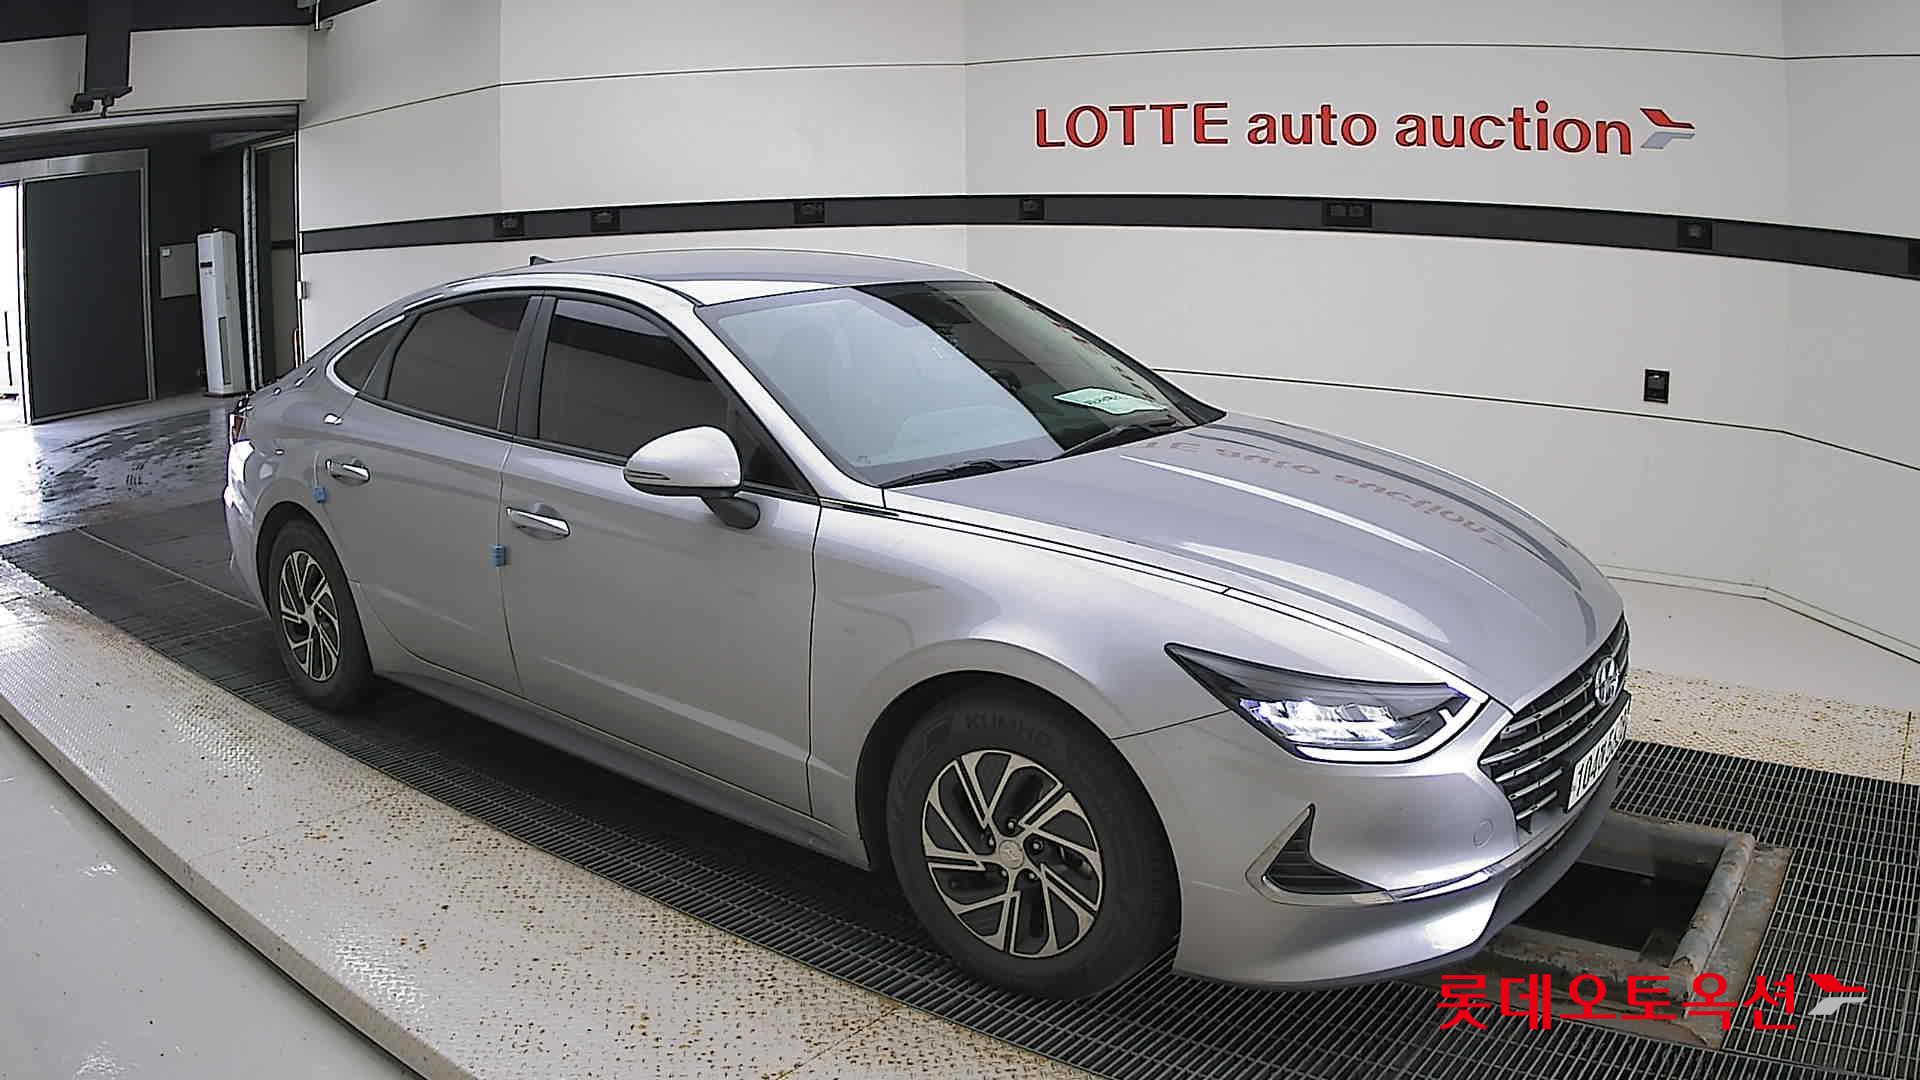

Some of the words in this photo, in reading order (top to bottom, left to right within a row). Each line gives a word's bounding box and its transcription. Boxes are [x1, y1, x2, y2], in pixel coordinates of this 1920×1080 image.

[1036, 103, 1229, 148] LOTTE
[1246, 105, 1377, 147] auto
[1396, 100, 1633, 156] auction
